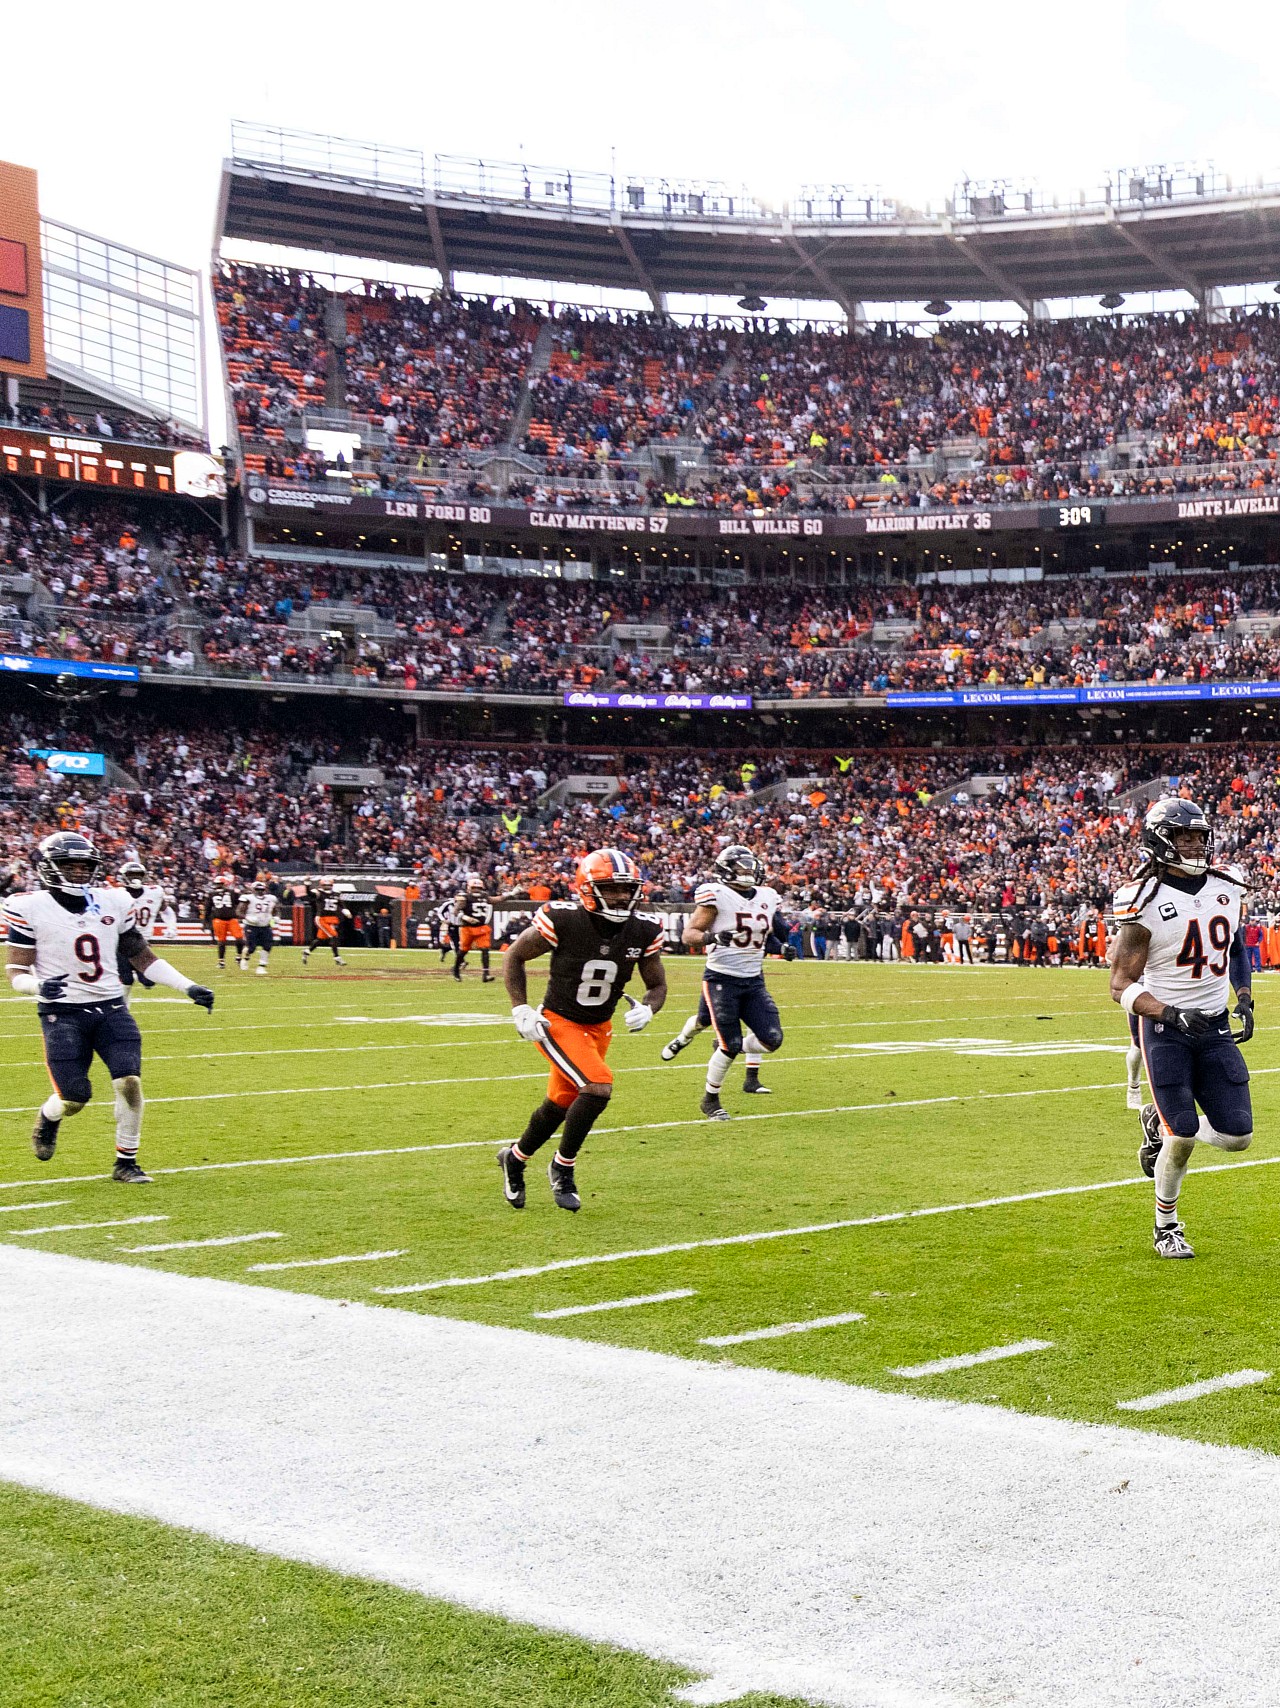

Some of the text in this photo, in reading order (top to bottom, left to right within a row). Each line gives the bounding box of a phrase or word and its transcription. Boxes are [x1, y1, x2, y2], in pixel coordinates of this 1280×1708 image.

[7, 456, 18, 472] 5
[268, 489, 352, 505] CROSSCOUNTRY
[385, 501, 491, 523] LEN FORD 80
[1059, 506, 1091, 526] 3:09
[1178, 500, 1222, 518] DANTE
[1224, 497, 1279, 514] LAVELLI
[530, 512, 668, 533] CLAY MATTHEWS 57
[719, 519, 823, 535] BILL WILLIS 60
[866, 513, 991, 532] MARION MOTLEY 36
[963, 693, 1001, 703] LECOM
[1087, 690, 1125, 700] LECOM
[1212, 686, 1251, 696] LECOM
[733, 912, 770, 950] 53
[1176, 915, 1231, 979] 49
[74, 934, 104, 983] 9
[576, 960, 618, 1006] 8
